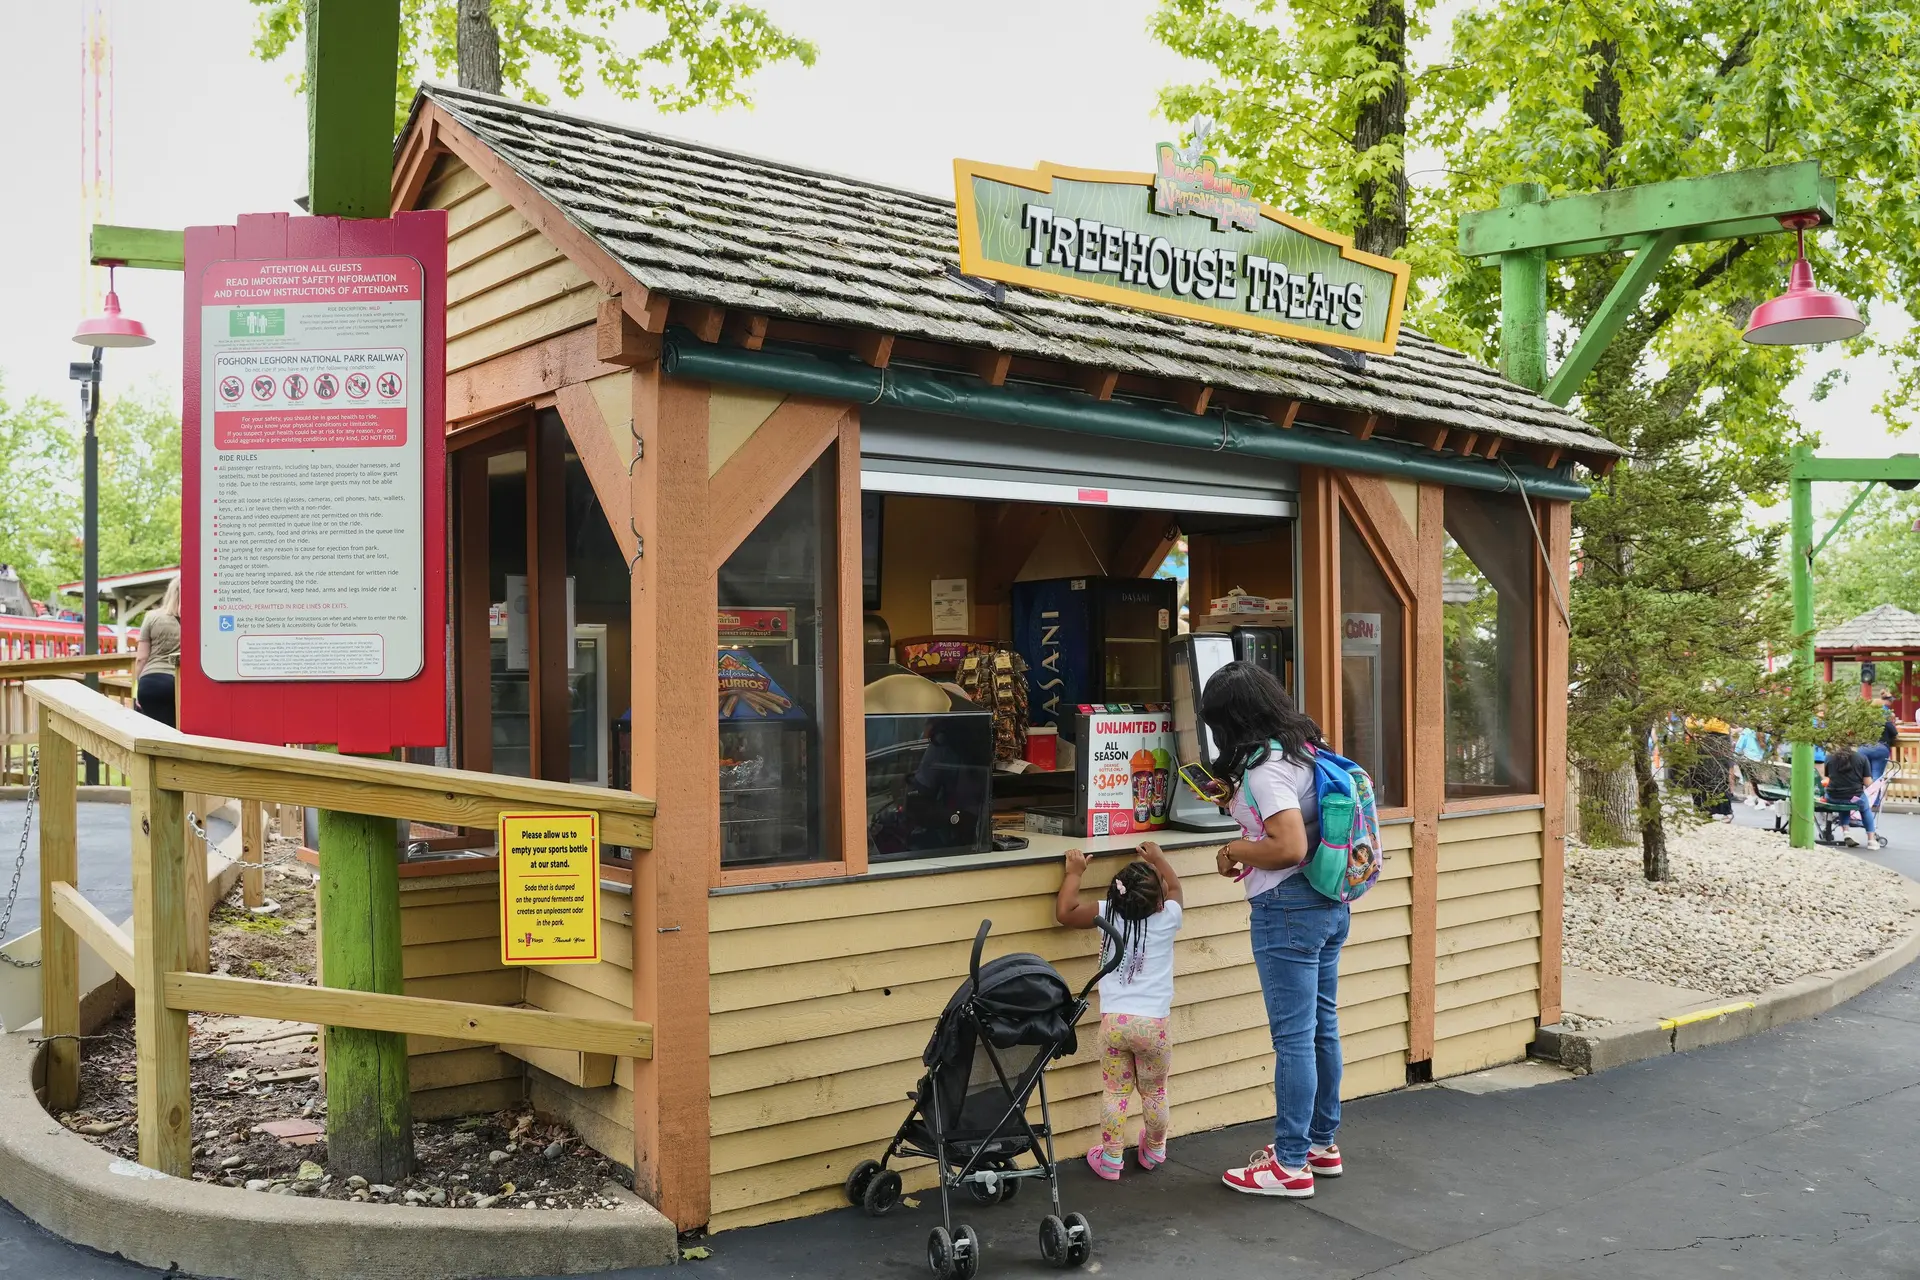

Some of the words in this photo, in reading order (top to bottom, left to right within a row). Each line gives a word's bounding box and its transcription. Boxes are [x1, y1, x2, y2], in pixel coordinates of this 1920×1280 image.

[1203, 159, 1250, 198] BUNNY
[1159, 178, 1220, 214] NATIONAL
[1219, 198, 1257, 226] PARK
[260, 265, 308, 274] ATTENTION
[329, 264, 361, 272] GUESTS
[1022, 202, 1238, 300] TREEHOUSE
[1243, 253, 1364, 329] TREATS
[252, 277, 300, 285] IMPORTANT
[302, 276, 334, 284] SAFETY
[338, 274, 396, 283] INFORMATION
[235, 289, 271, 297] FOLLOW
[274, 287, 335, 296] INSTRUCTIONS
[352, 285, 408, 294] ATTENDANTS
[260, 356, 298, 364] LEGHORN
[301, 355, 341, 363] NATIONAL
[368, 354, 404, 362] RAILWAY
[1122, 593, 1150, 602] DASANI
[1345, 618, 1373, 639] CORN
[718, 669, 755, 678] alifornia
[718, 679, 764, 690] HURROS
[1096, 722, 1157, 734] UNLIMITED
[1105, 742, 1118, 750] ALL
[1094, 751, 1128, 761] SEASON
[522, 831, 542, 839] Please
[512, 846, 531, 856] empty
[533, 847, 547, 855] your
[548, 846, 568, 855] sports
[569, 844, 588, 853] bottle
[550, 860, 569, 868] stand.
[533, 896, 550, 904] ground
